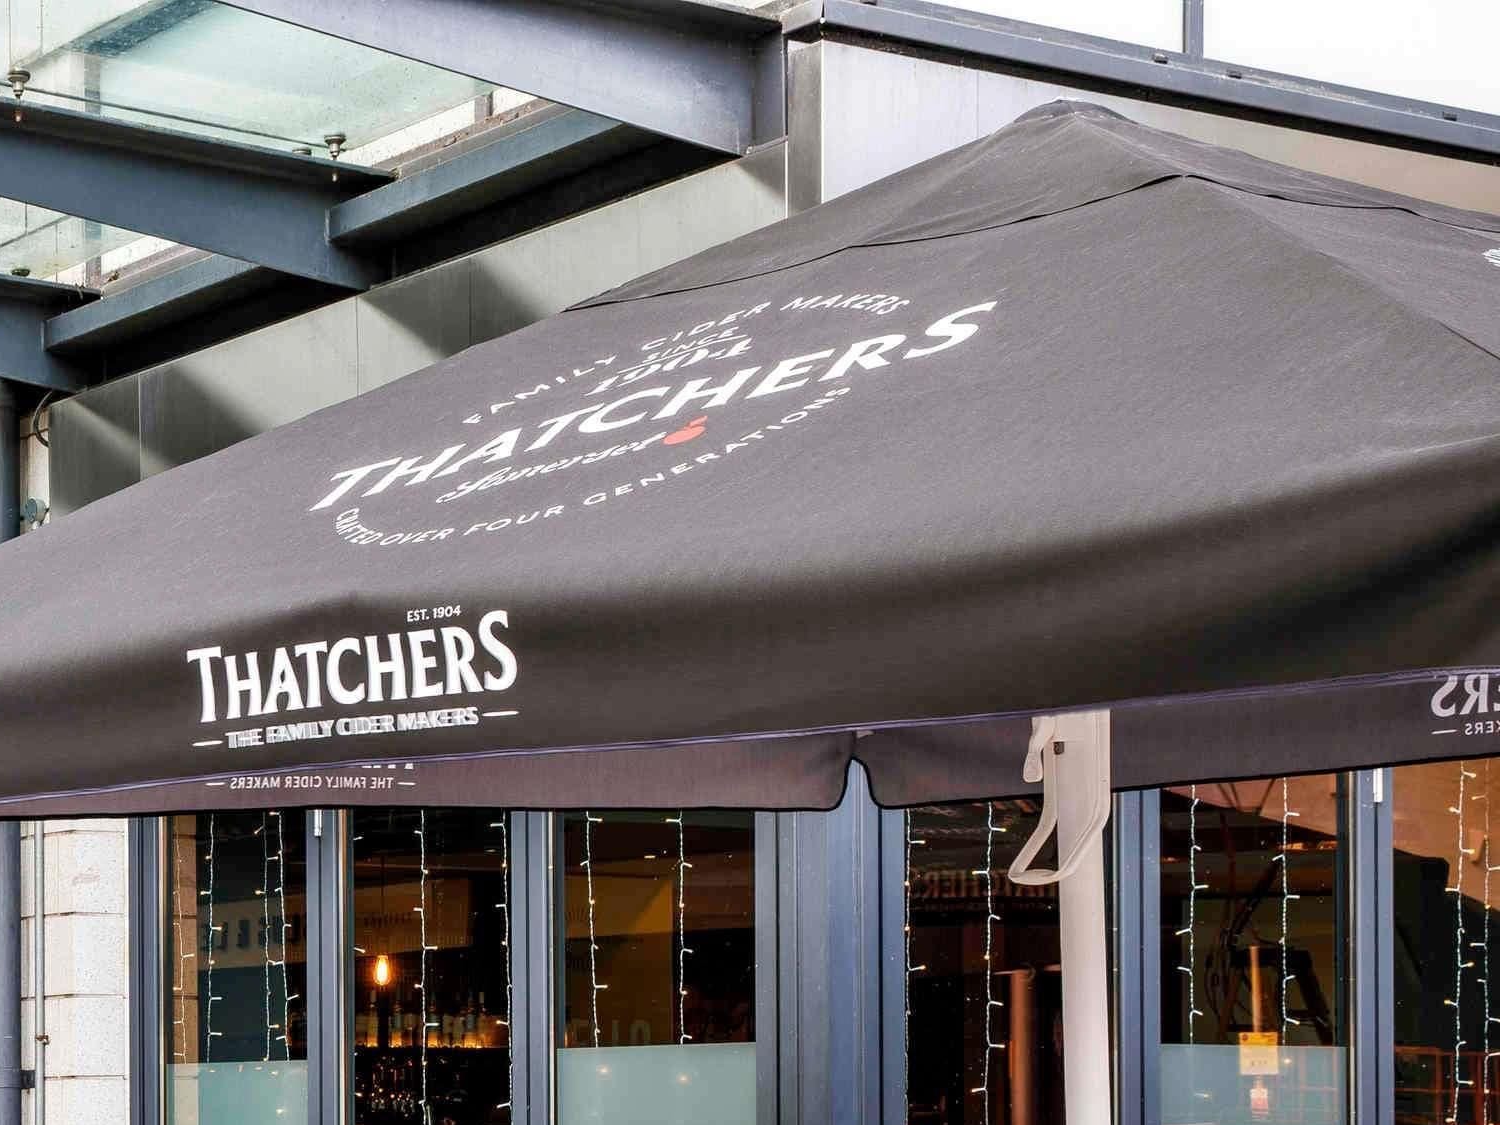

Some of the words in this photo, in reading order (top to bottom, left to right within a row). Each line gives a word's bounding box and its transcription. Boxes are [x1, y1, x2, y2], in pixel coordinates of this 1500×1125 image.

[462, 355, 617, 424] FAMILY
[642, 302, 771, 351] CIDER
[780, 294, 909, 315] MAKERS
[585, 338, 753, 397] 1904
[644, 327, 739, 363] SINCE
[309, 301, 997, 511] THATCHERS
[335, 508, 380, 545] CRAFTED
[380, 528, 454, 546] OVER
[463, 505, 565, 536] FOUR
[583, 387, 850, 505] GENERATIONS
[407, 609, 430, 622] EST.
[432, 605, 461, 620] 1904
[186, 610, 518, 723] THATCHERS
[225, 728, 265, 749] THE
[266, 720, 334, 743] FAMILY
[336, 715, 396, 736] CIDER
[397, 707, 479, 731] MAKERS
